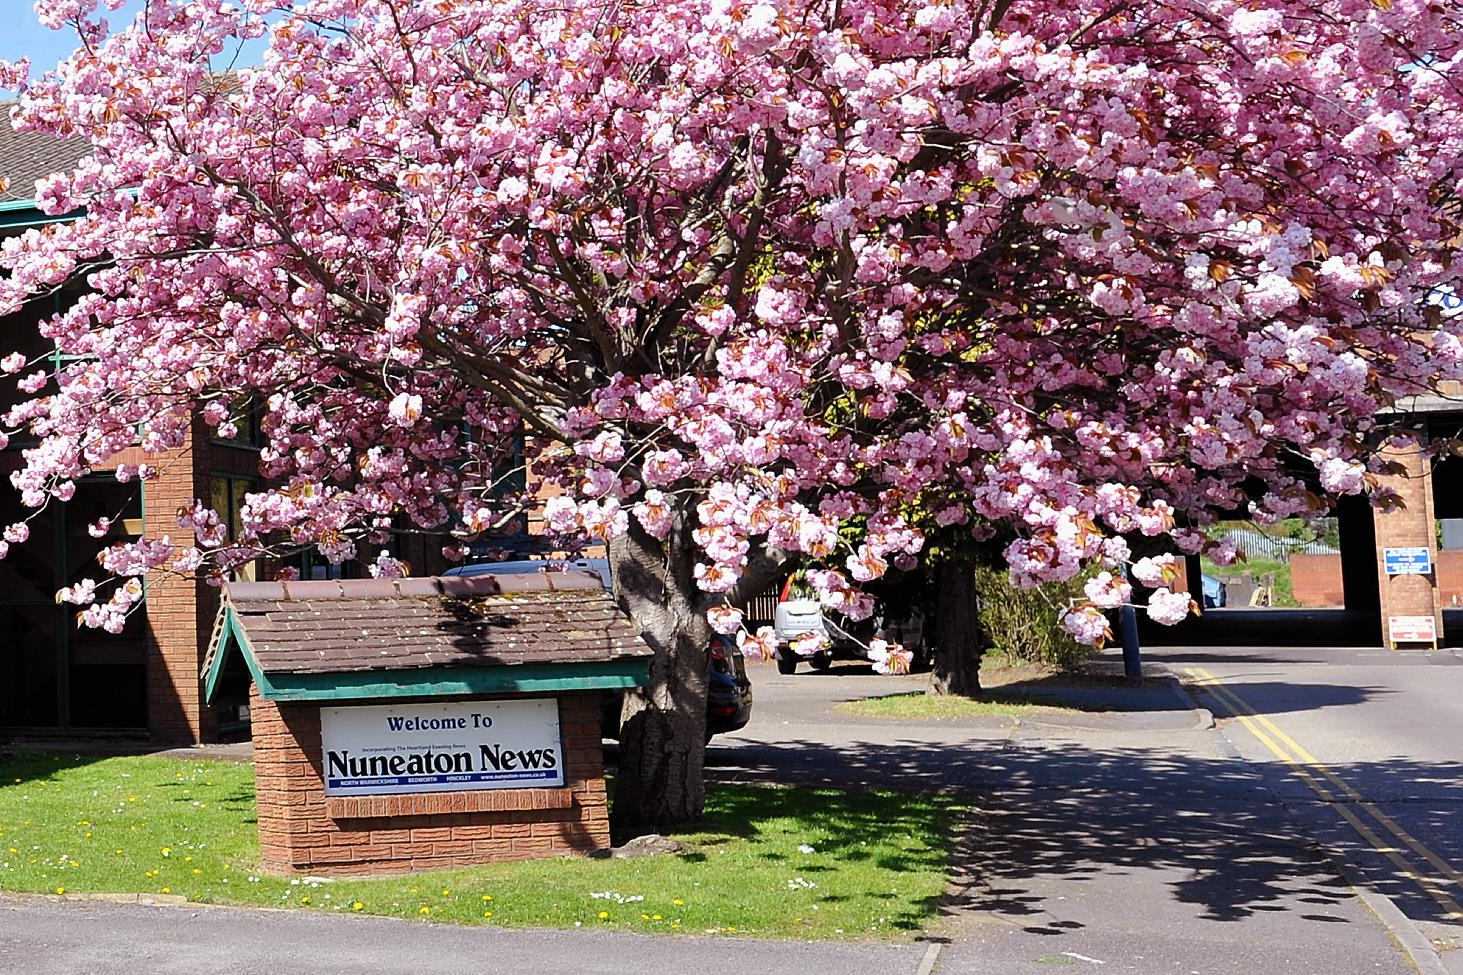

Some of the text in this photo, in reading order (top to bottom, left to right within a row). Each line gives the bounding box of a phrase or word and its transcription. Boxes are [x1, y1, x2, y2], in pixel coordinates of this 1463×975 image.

[387, 713, 493, 732] Welcome To
[327, 744, 557, 779] Nuneaton News
[480, 772, 546, 780] www.nuneaton-news.co.uk
